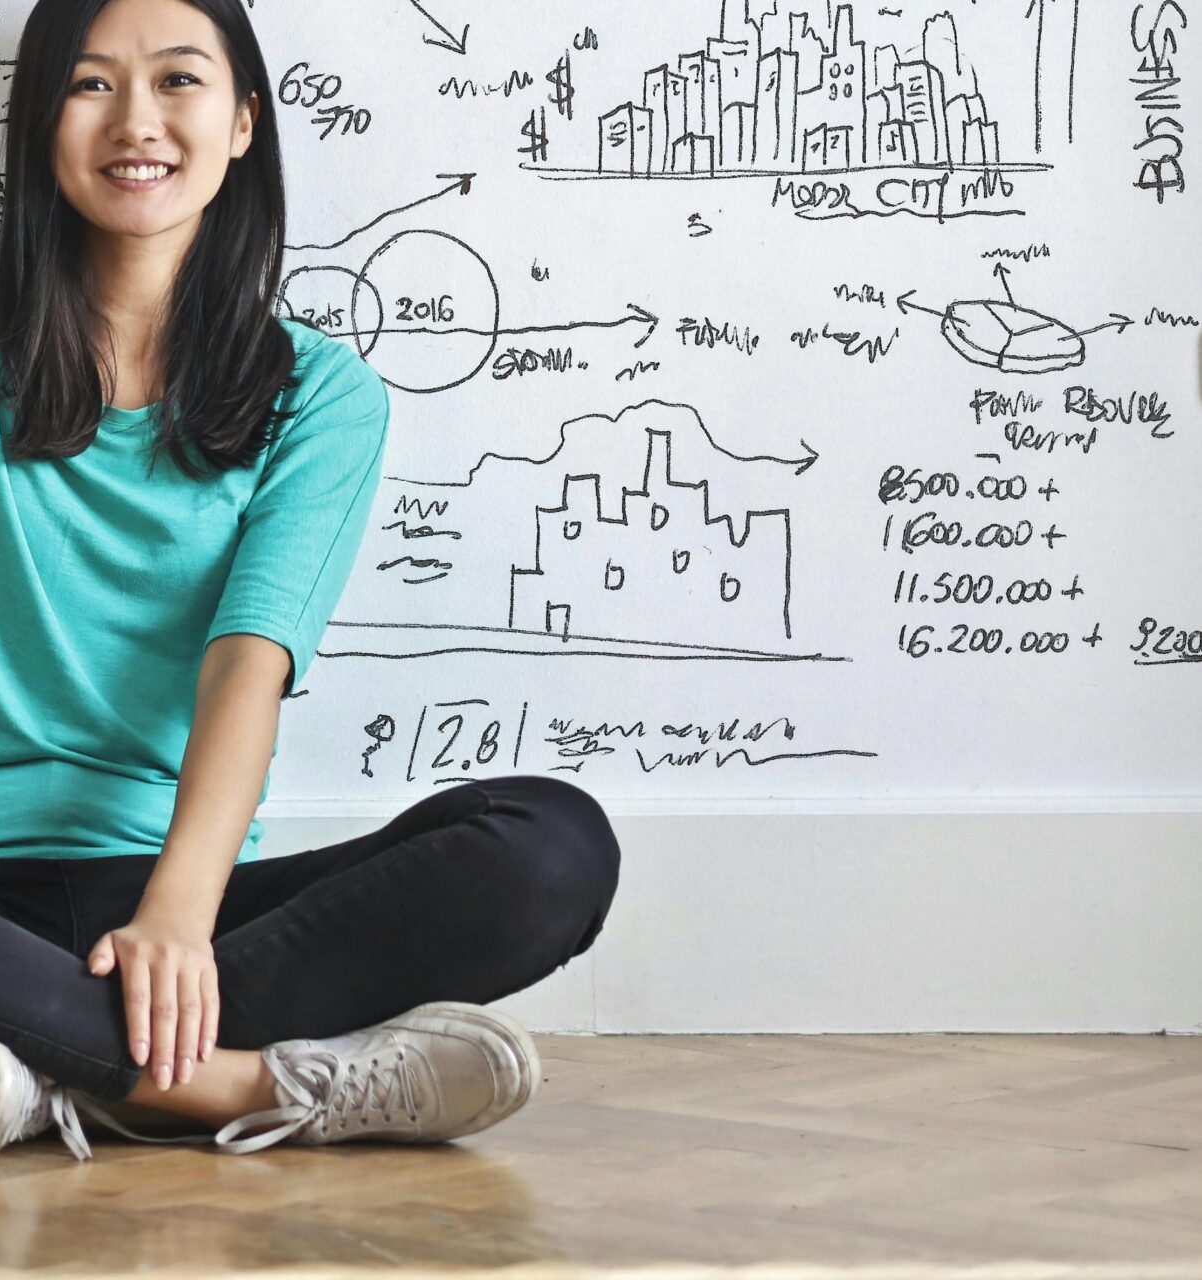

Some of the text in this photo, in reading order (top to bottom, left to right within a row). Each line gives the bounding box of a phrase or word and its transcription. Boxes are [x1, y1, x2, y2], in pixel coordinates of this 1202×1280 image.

[278, 62, 344, 108] 650
[876, 172, 950, 224] CITY
[395, 294, 456, 323] 2016
[894, 570, 1053, 605] 11.500.000
[898, 623, 1070, 659] 16.200.000
